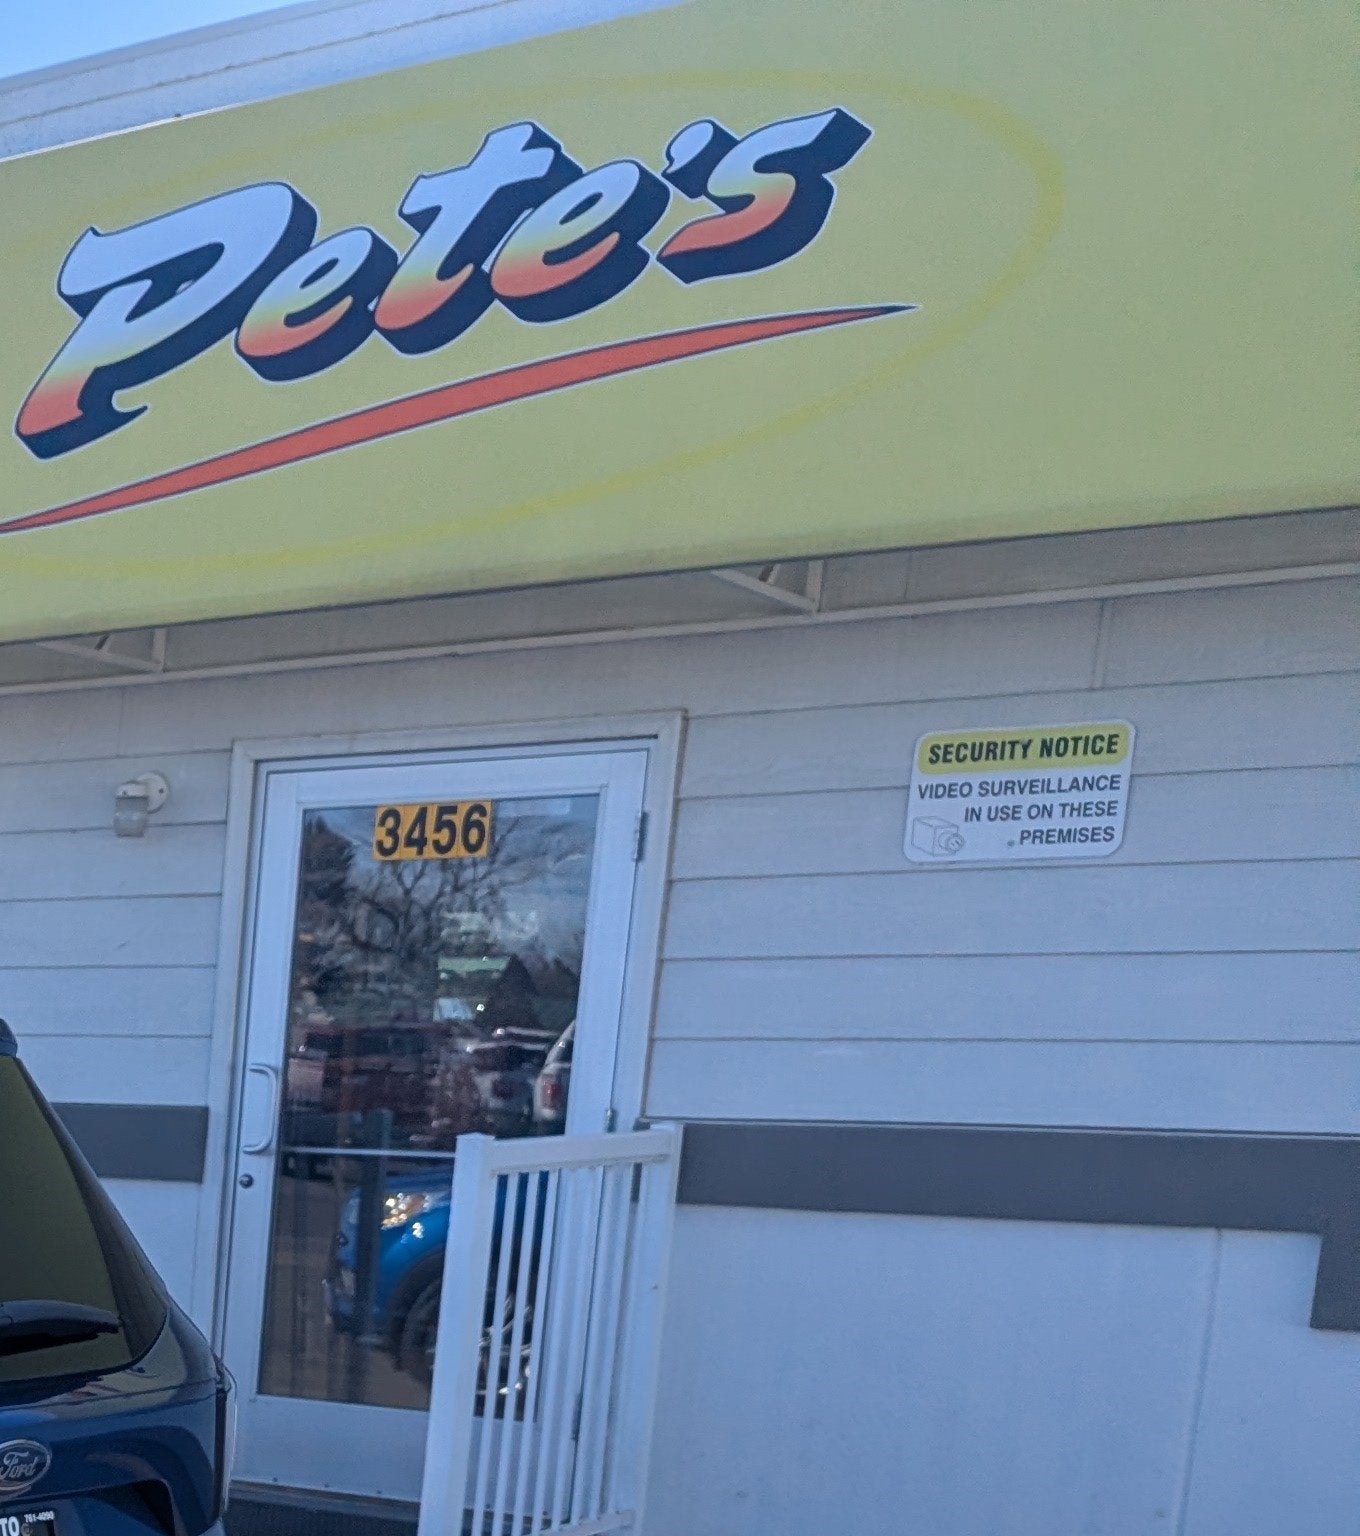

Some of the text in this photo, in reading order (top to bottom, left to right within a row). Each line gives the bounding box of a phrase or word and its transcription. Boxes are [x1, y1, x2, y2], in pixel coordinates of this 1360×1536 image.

[15, 107, 872, 460] Pete's
[929, 734, 1120, 765] SECURITY NOTICE
[918, 774, 1121, 799] VIDEO SURVEILLANCE
[964, 800, 1119, 822] IN USE ON THESE
[377, 804, 487, 857] 3456
[1020, 826, 1115, 846] PREMISES
